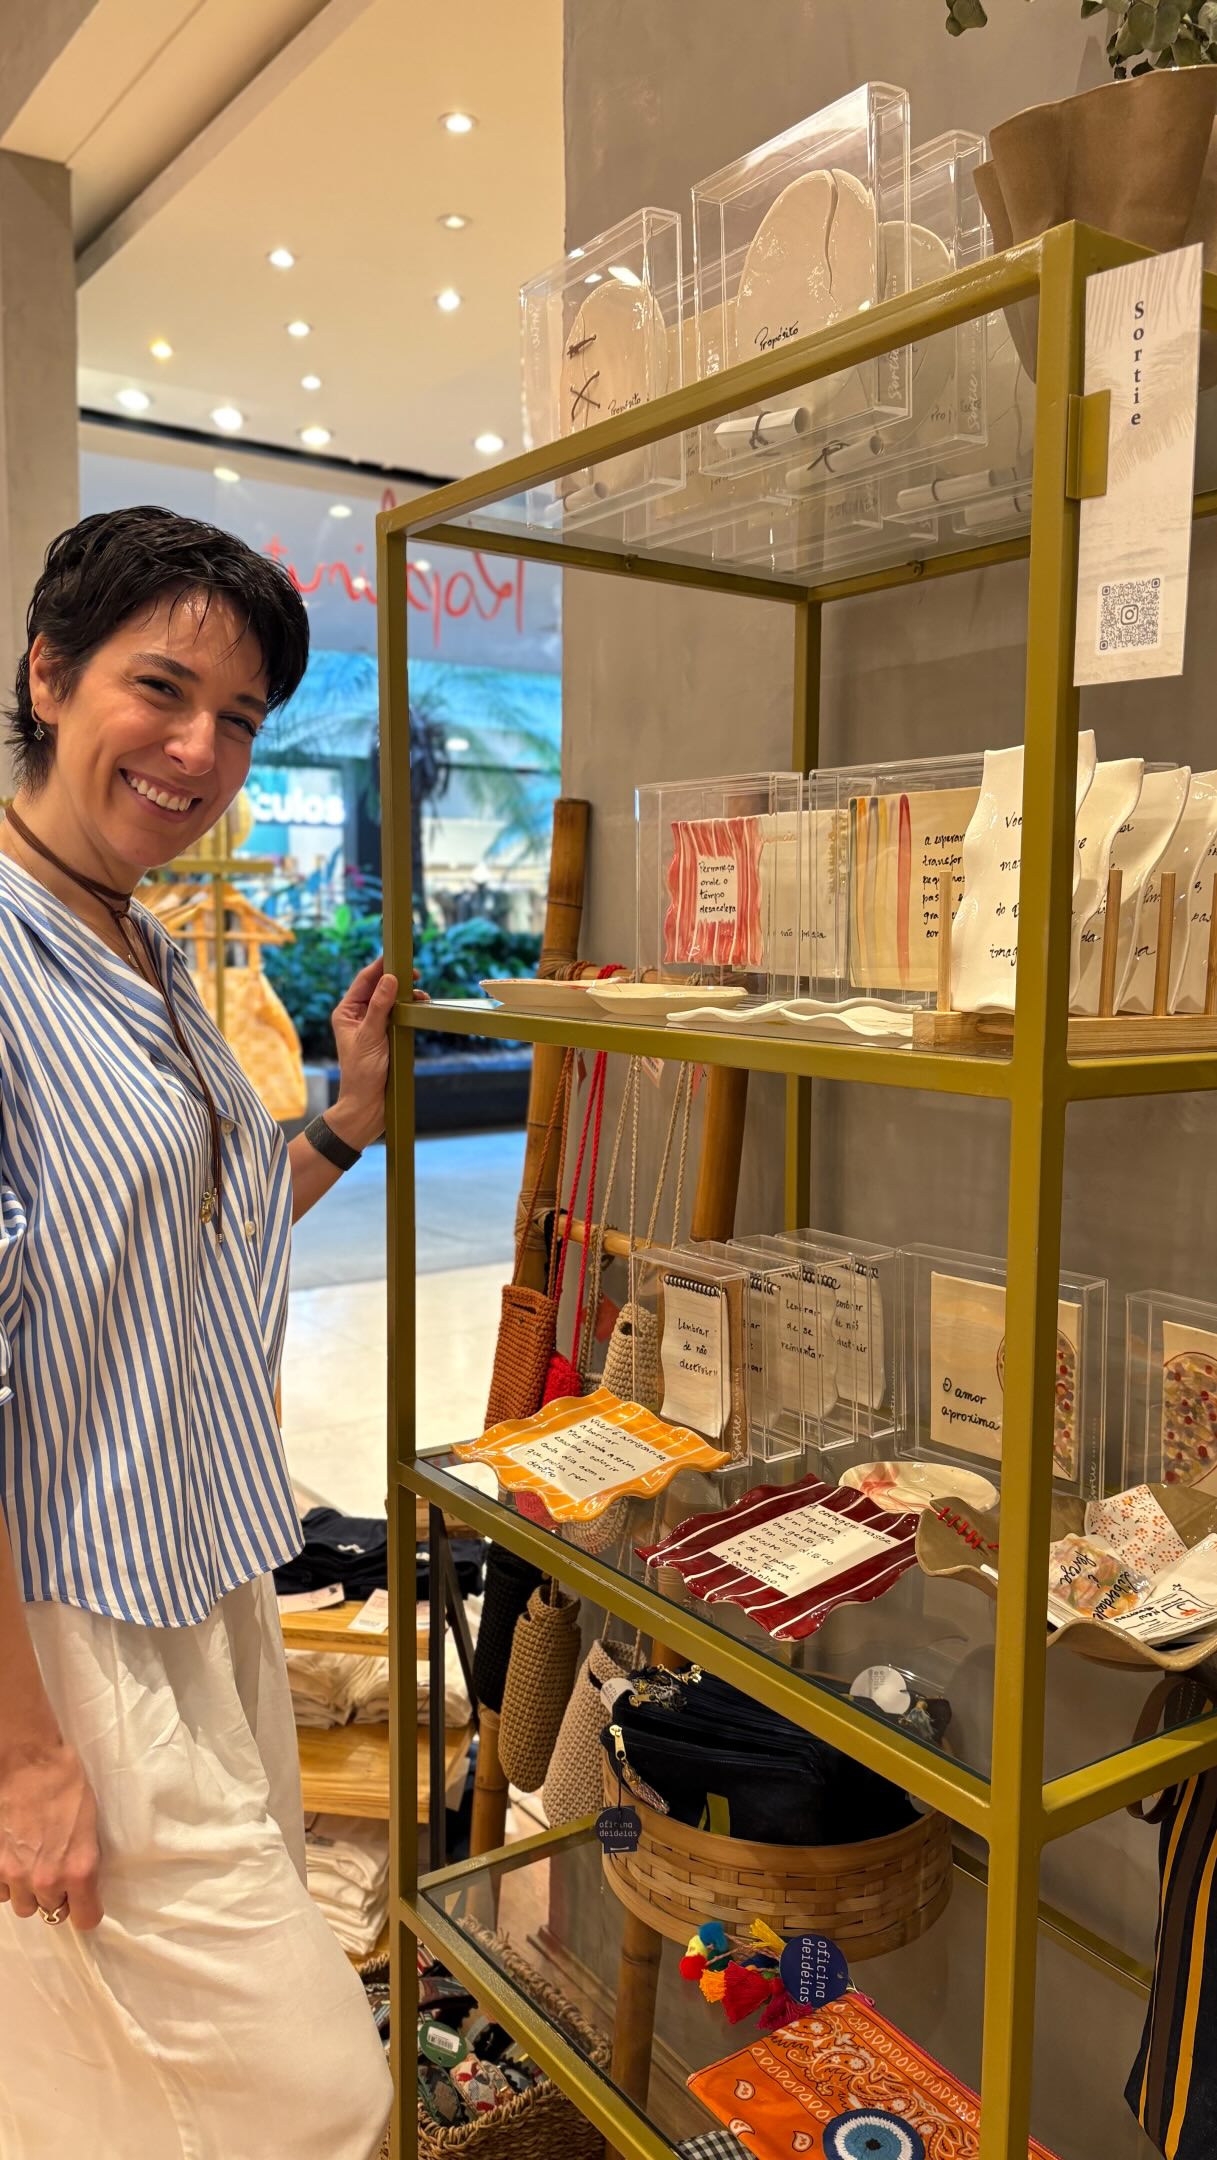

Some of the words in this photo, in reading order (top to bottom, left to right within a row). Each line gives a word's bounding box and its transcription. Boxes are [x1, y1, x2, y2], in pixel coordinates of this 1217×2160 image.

[754, 320, 799, 351] Propósito
[1130, 301, 1145, 425] Sortie
[683, 1340, 691, 1351] de
[942, 1377, 952, 1392] O
[954, 1387, 987, 1404] amor
[941, 1405, 1000, 1431] aproxima
[818, 1510, 859, 1530] coragem
[799, 1938, 815, 2003] deidéias
[815, 1940, 831, 1999] oficina
